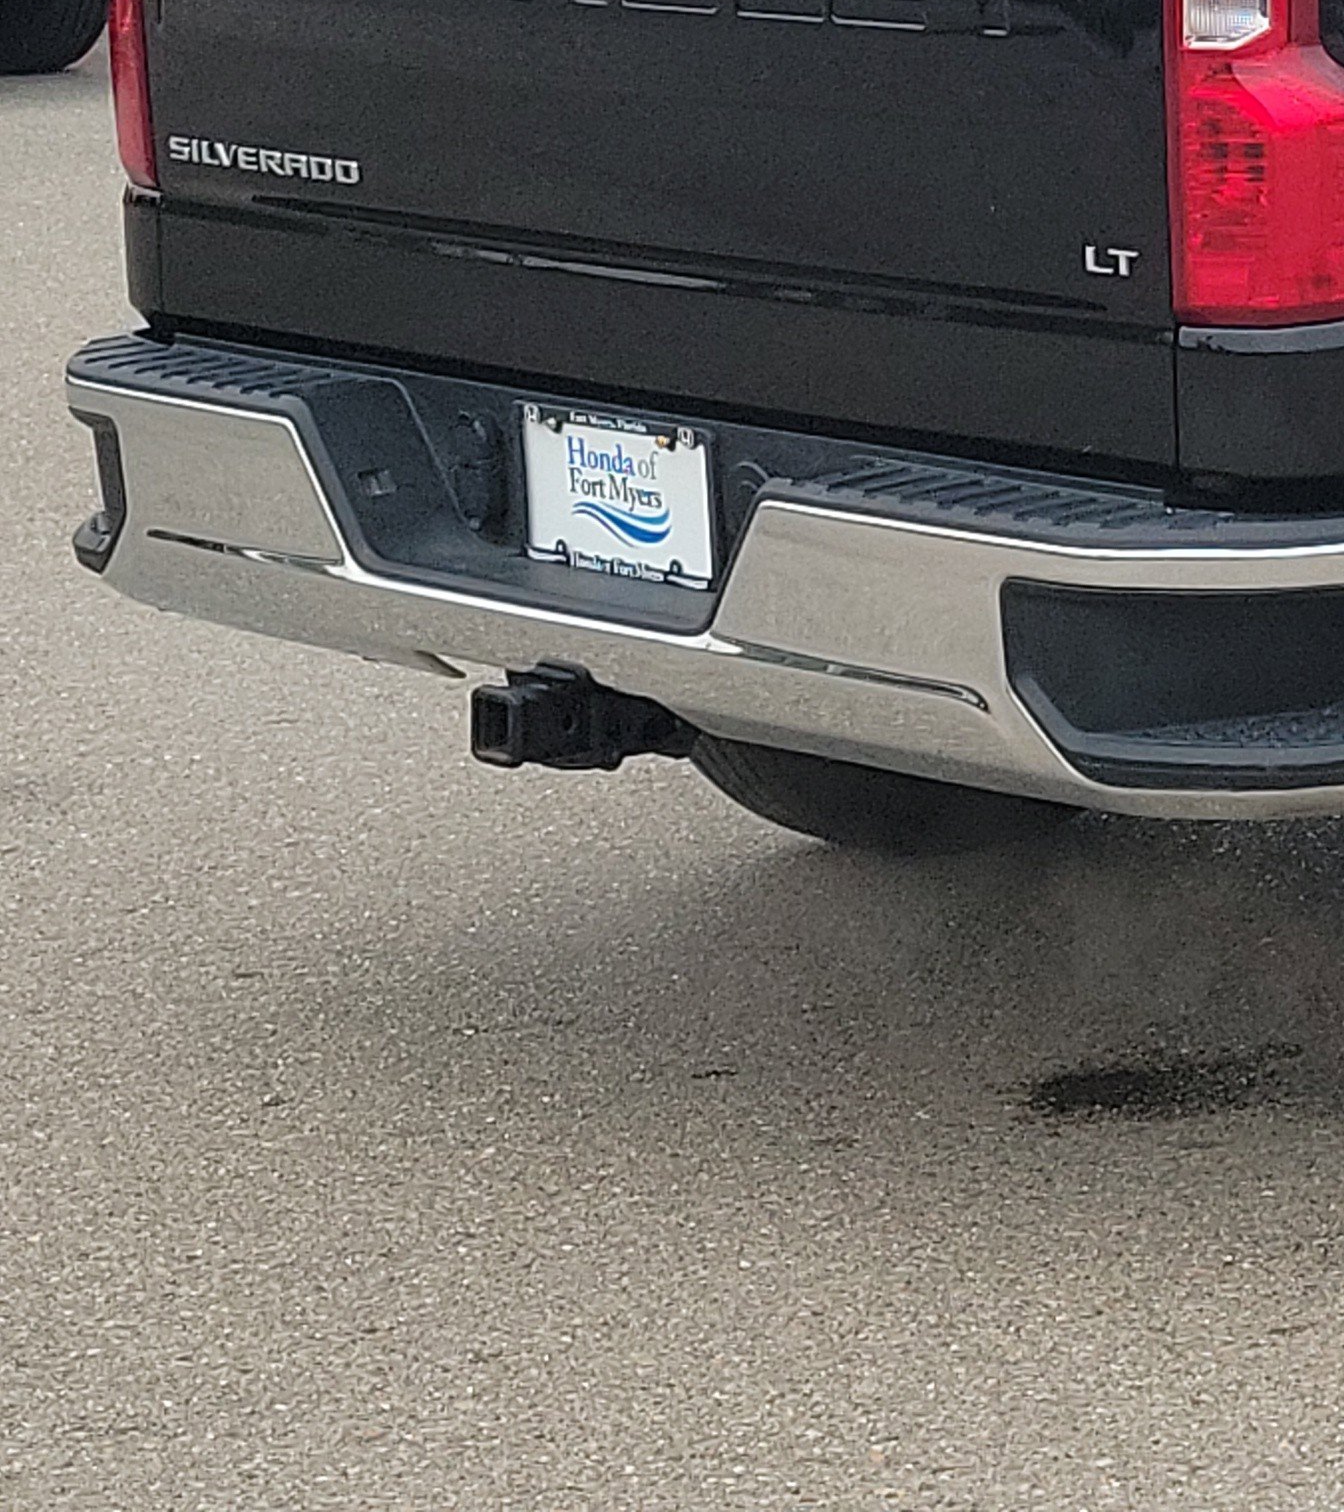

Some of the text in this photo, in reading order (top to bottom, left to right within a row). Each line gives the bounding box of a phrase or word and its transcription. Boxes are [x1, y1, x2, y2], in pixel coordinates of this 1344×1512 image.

[168, 135, 361, 185] SILVERADO
[1085, 245, 1140, 276] LT
[567, 436, 659, 481] Honda of
[569, 467, 663, 512] Fort Myers
